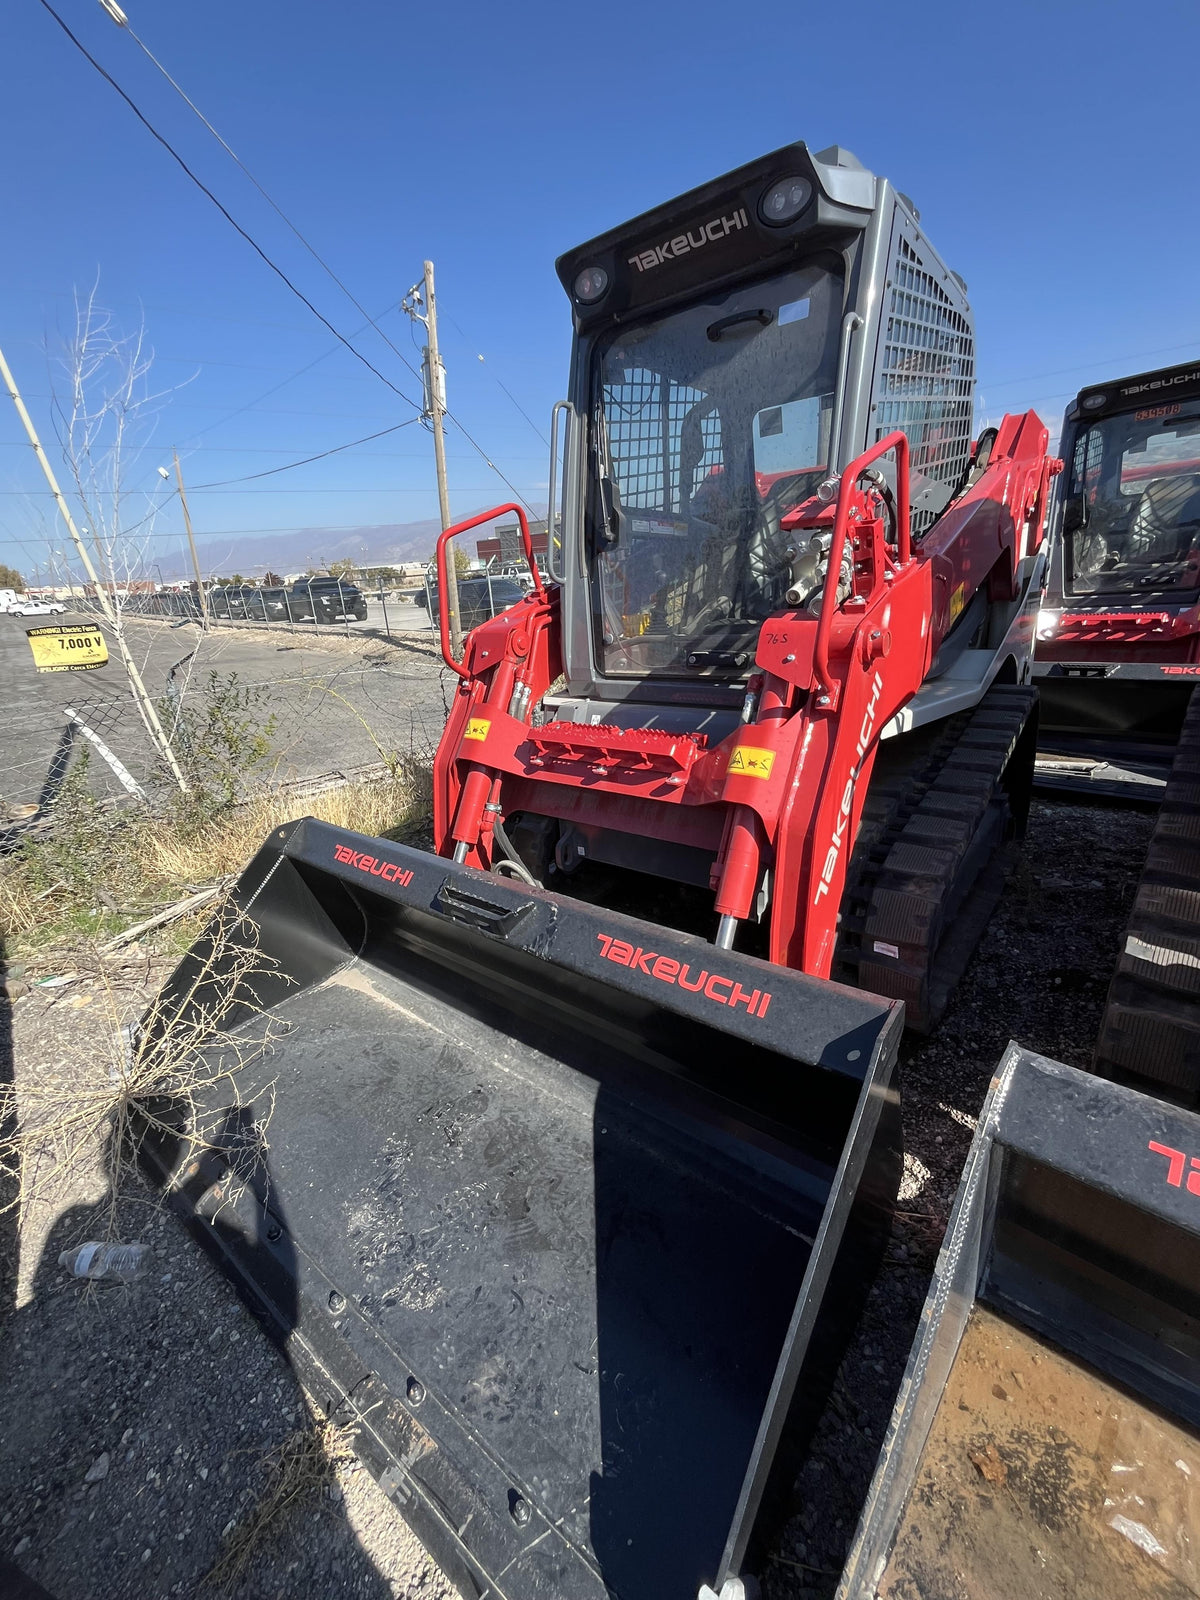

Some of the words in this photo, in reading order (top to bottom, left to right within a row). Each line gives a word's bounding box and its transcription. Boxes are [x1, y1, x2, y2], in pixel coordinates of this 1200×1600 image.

[628, 208, 749, 272] TAKEUCHI
[58, 636, 92, 651] 7,000
[94, 636, 101, 647] V
[62, 625, 82, 633] Electric
[334, 844, 415, 887] TAKEUCHI
[597, 933, 772, 1019] TAKEUCHI
